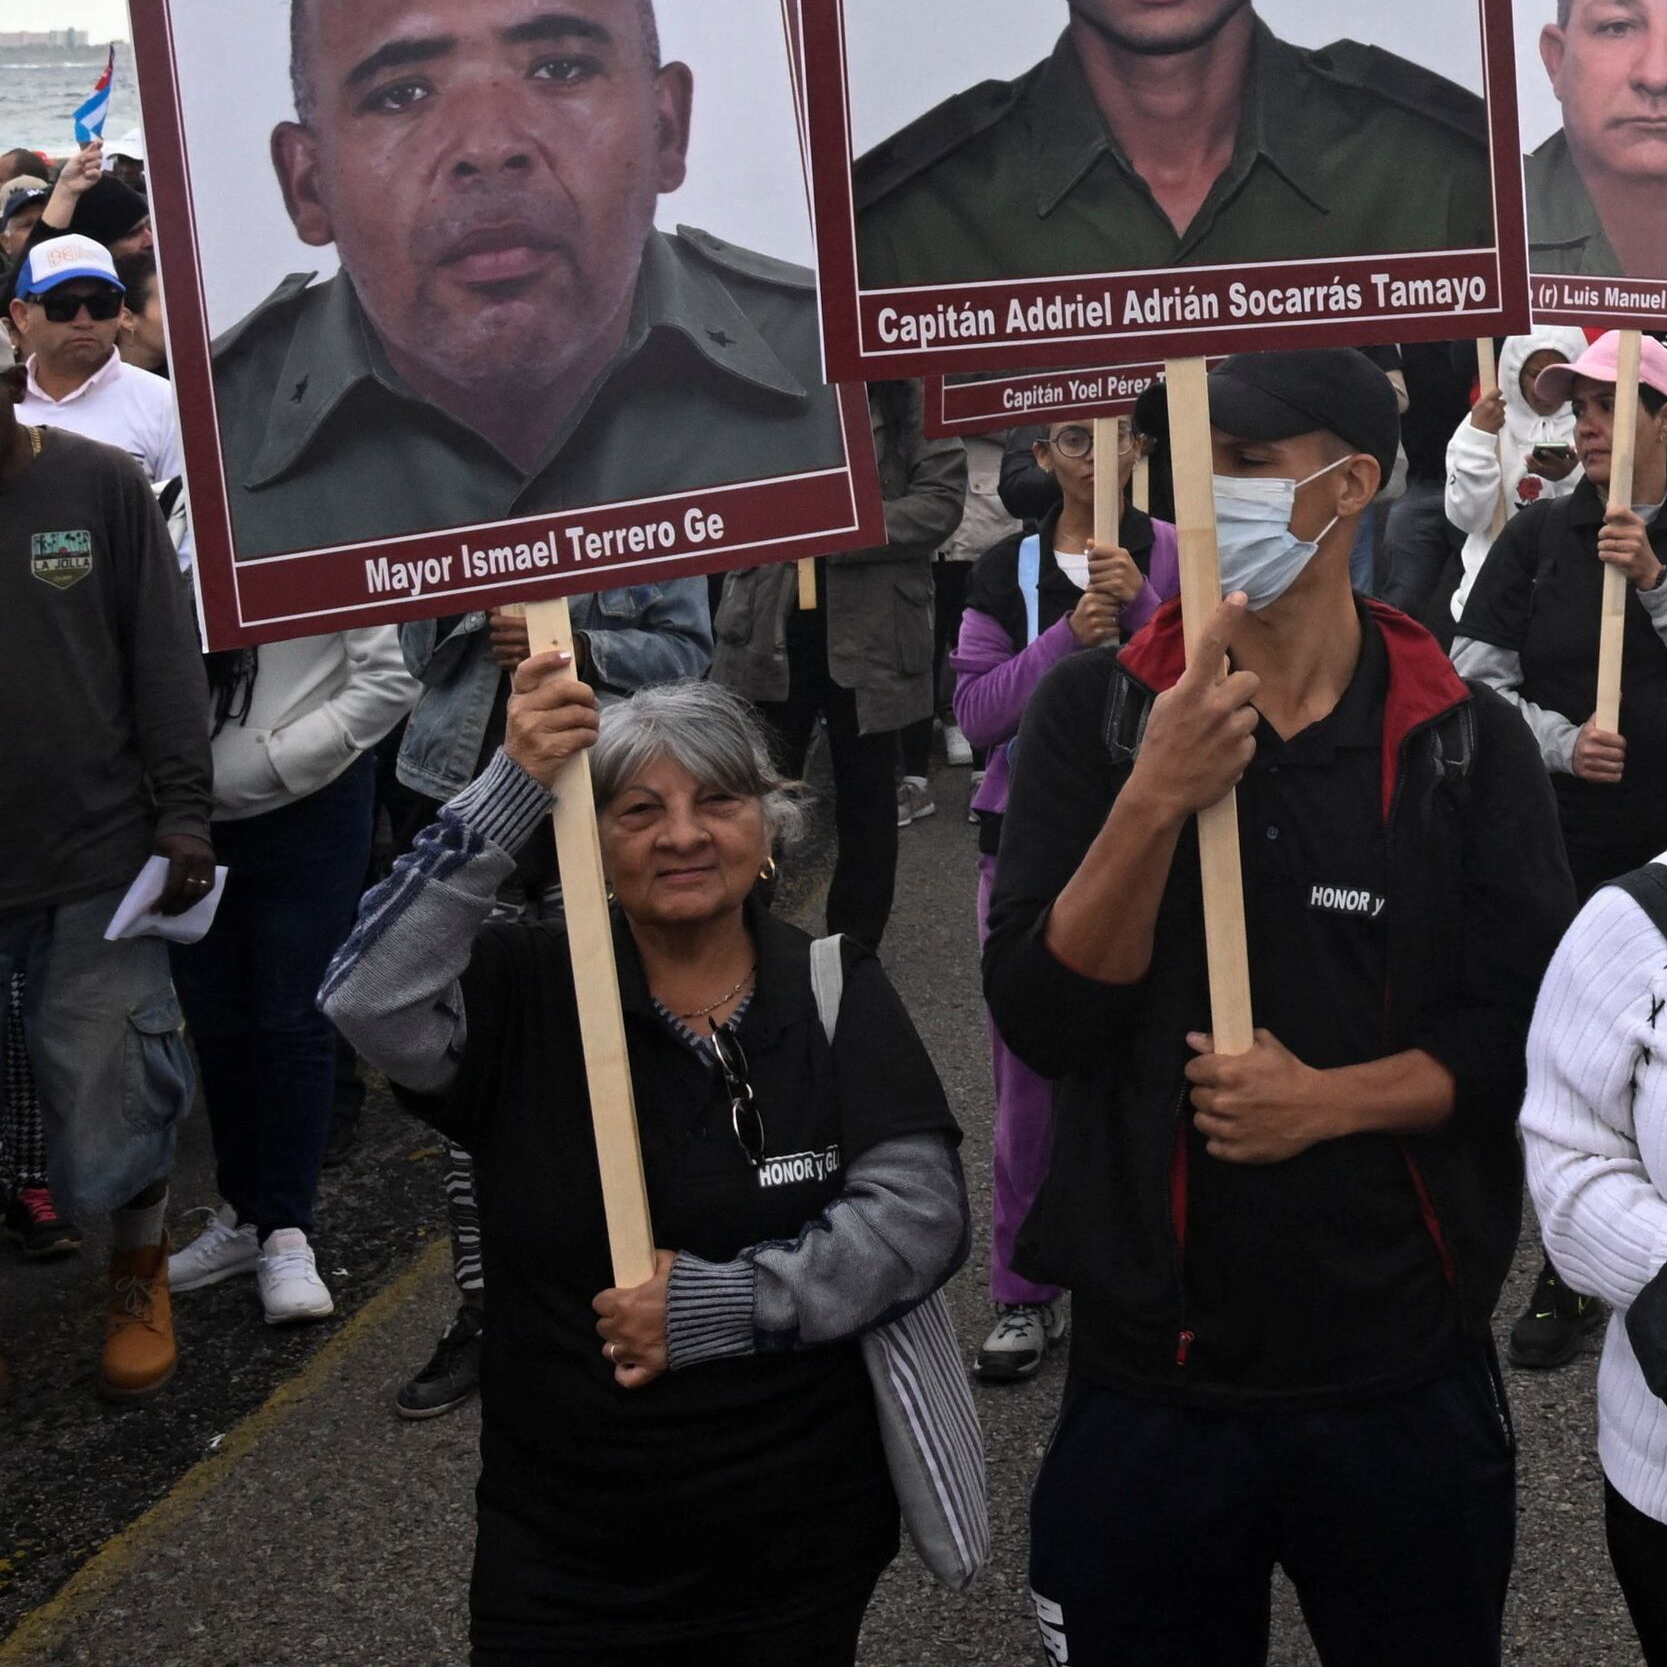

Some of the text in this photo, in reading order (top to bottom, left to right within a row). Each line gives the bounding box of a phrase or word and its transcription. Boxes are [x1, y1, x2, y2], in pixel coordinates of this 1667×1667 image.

[879, 274, 1487, 348] Capitán Addriel Adrián Socarrás Tamayo
[1538, 283, 1558, 309] (r)
[1564, 283, 1600, 307] Luis
[1605, 287, 1667, 310] Manuel
[1003, 383, 1063, 411] Capitán
[1068, 377, 1103, 401] Yoel
[1108, 375, 1152, 397] Pérez
[34, 557, 90, 571] LA JOLLA
[365, 507, 724, 597] Mayor Ismael Terrero Ge
[1310, 886, 1386, 916] HONOR y
[760, 1157, 815, 1187] HONOR
[816, 1160, 823, 1181] y
